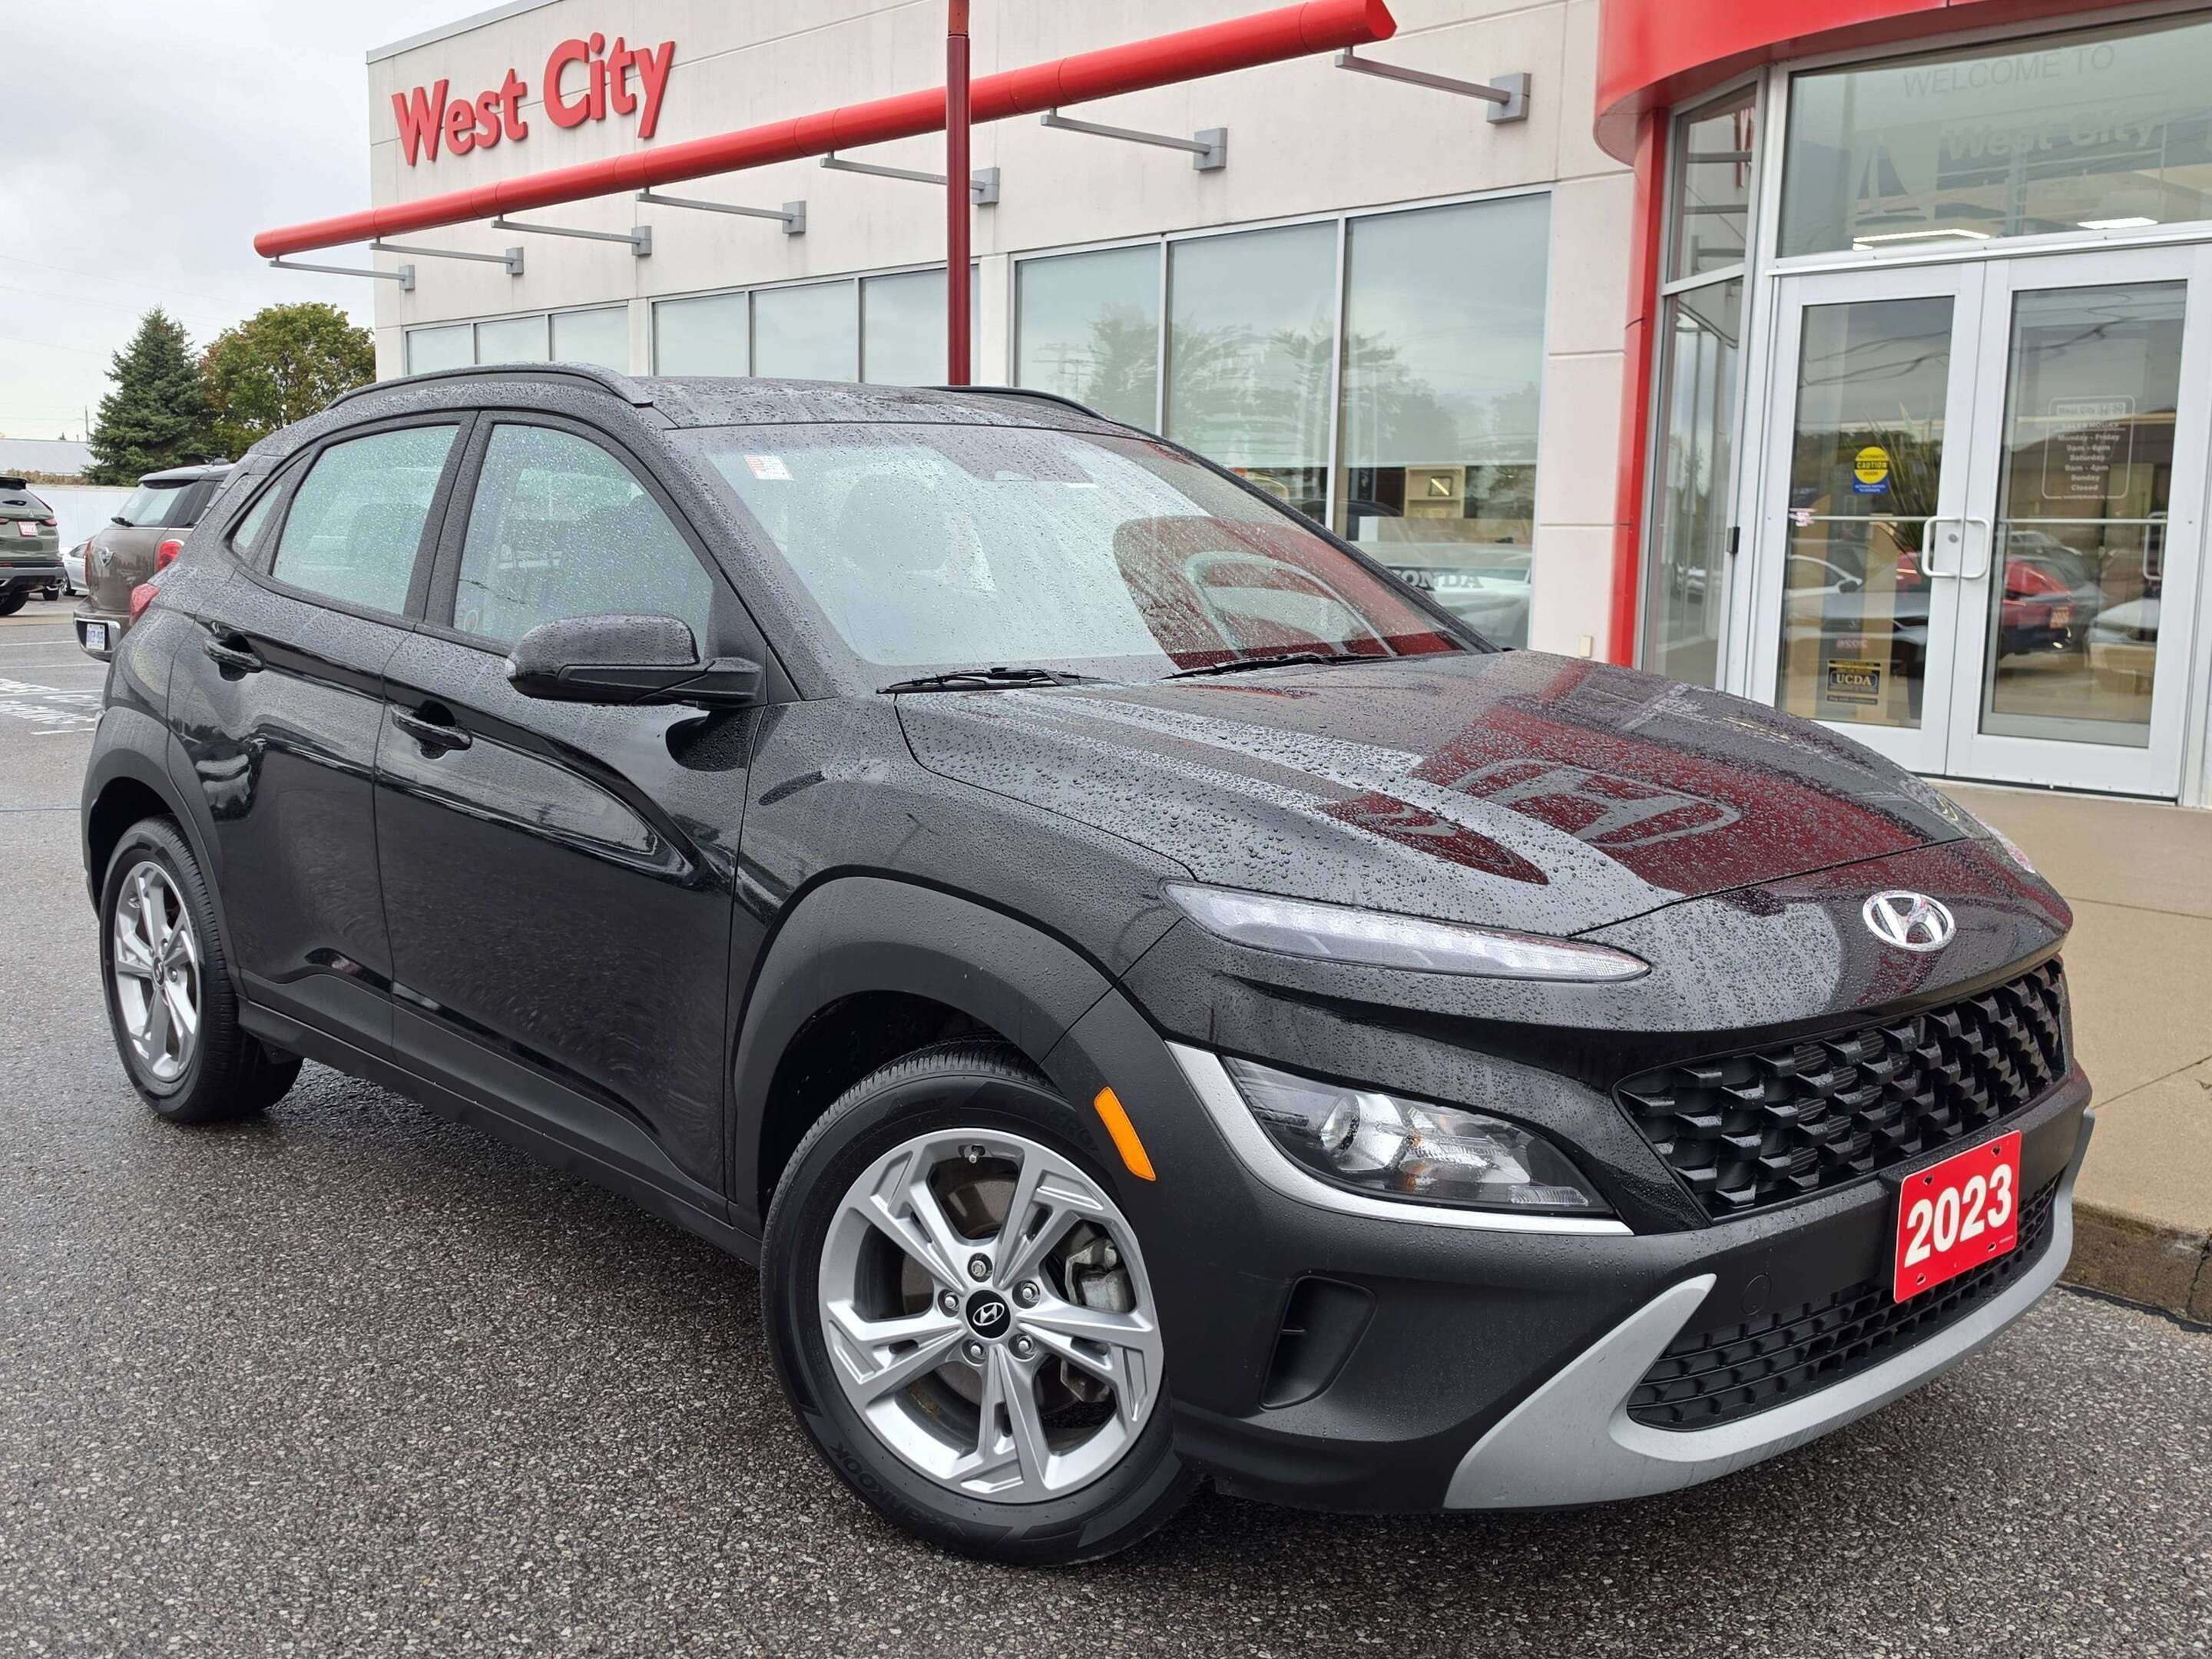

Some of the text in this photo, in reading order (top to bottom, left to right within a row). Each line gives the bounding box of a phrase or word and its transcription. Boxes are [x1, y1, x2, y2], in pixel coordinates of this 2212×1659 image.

[1902, 45, 2114, 98] WELCOME TO
[391, 31, 675, 167] West City
[1942, 117, 2053, 160] West
[2071, 108, 2157, 147] City
[2095, 433, 2120, 442] Friday
[2069, 454, 2105, 462] Saturday
[2071, 474, 2101, 482] Sunday
[1389, 569, 1484, 588] ONDA
[1836, 674, 1872, 687] UCDA
[1904, 1164, 2012, 1268] 2023
